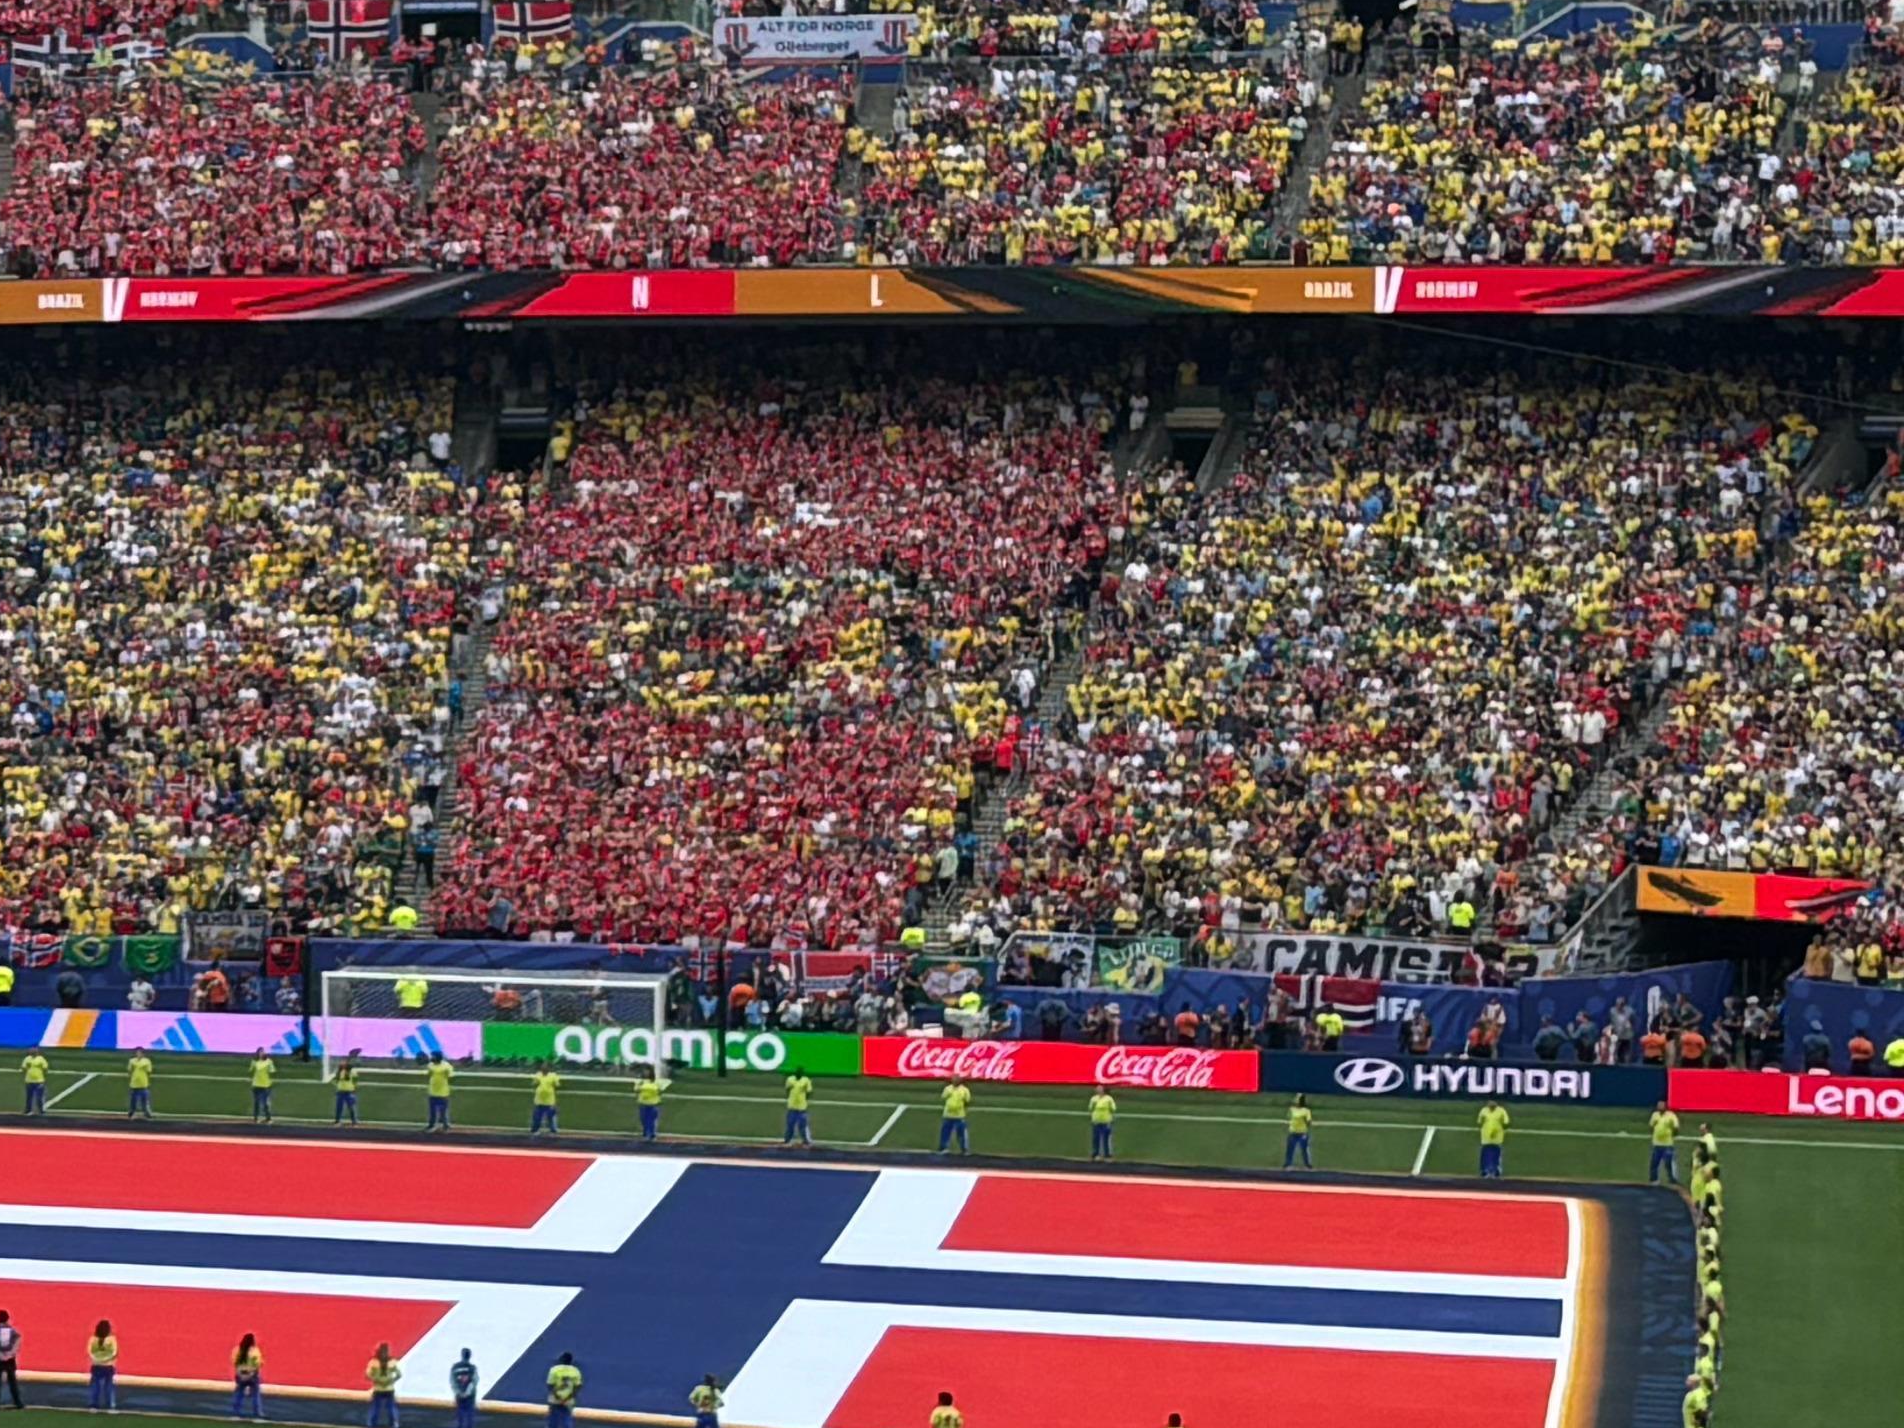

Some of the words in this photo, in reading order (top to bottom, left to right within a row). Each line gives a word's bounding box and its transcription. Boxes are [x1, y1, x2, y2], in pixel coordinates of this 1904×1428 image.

[757, 21, 784, 33] ALT
[788, 20, 818, 33] FOR
[554, 1025, 786, 1071] aramco
[1413, 1063, 1591, 1099] HYUNDAI
